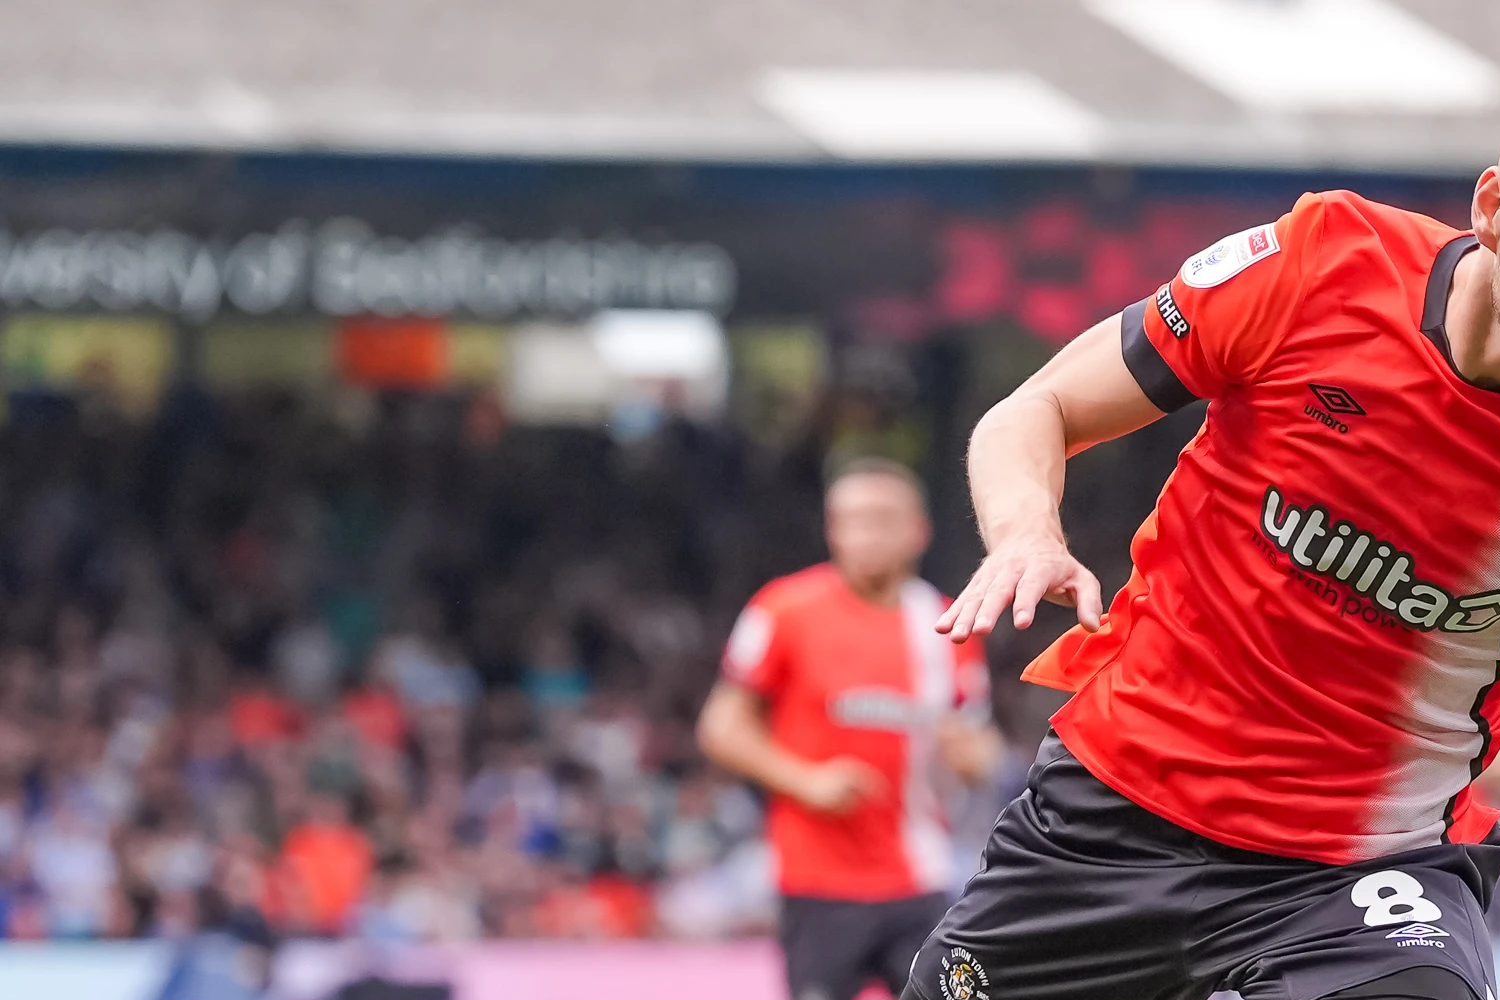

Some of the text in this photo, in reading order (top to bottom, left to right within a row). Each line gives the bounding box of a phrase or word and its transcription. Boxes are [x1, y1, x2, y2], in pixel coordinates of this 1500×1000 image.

[1303, 404, 1349, 434] umbro
[1262, 488, 1450, 628] utilita
[1351, 870, 1442, 927] 8
[1397, 938, 1445, 949] umbro
[951, 947, 990, 987] LUTON TOWN
